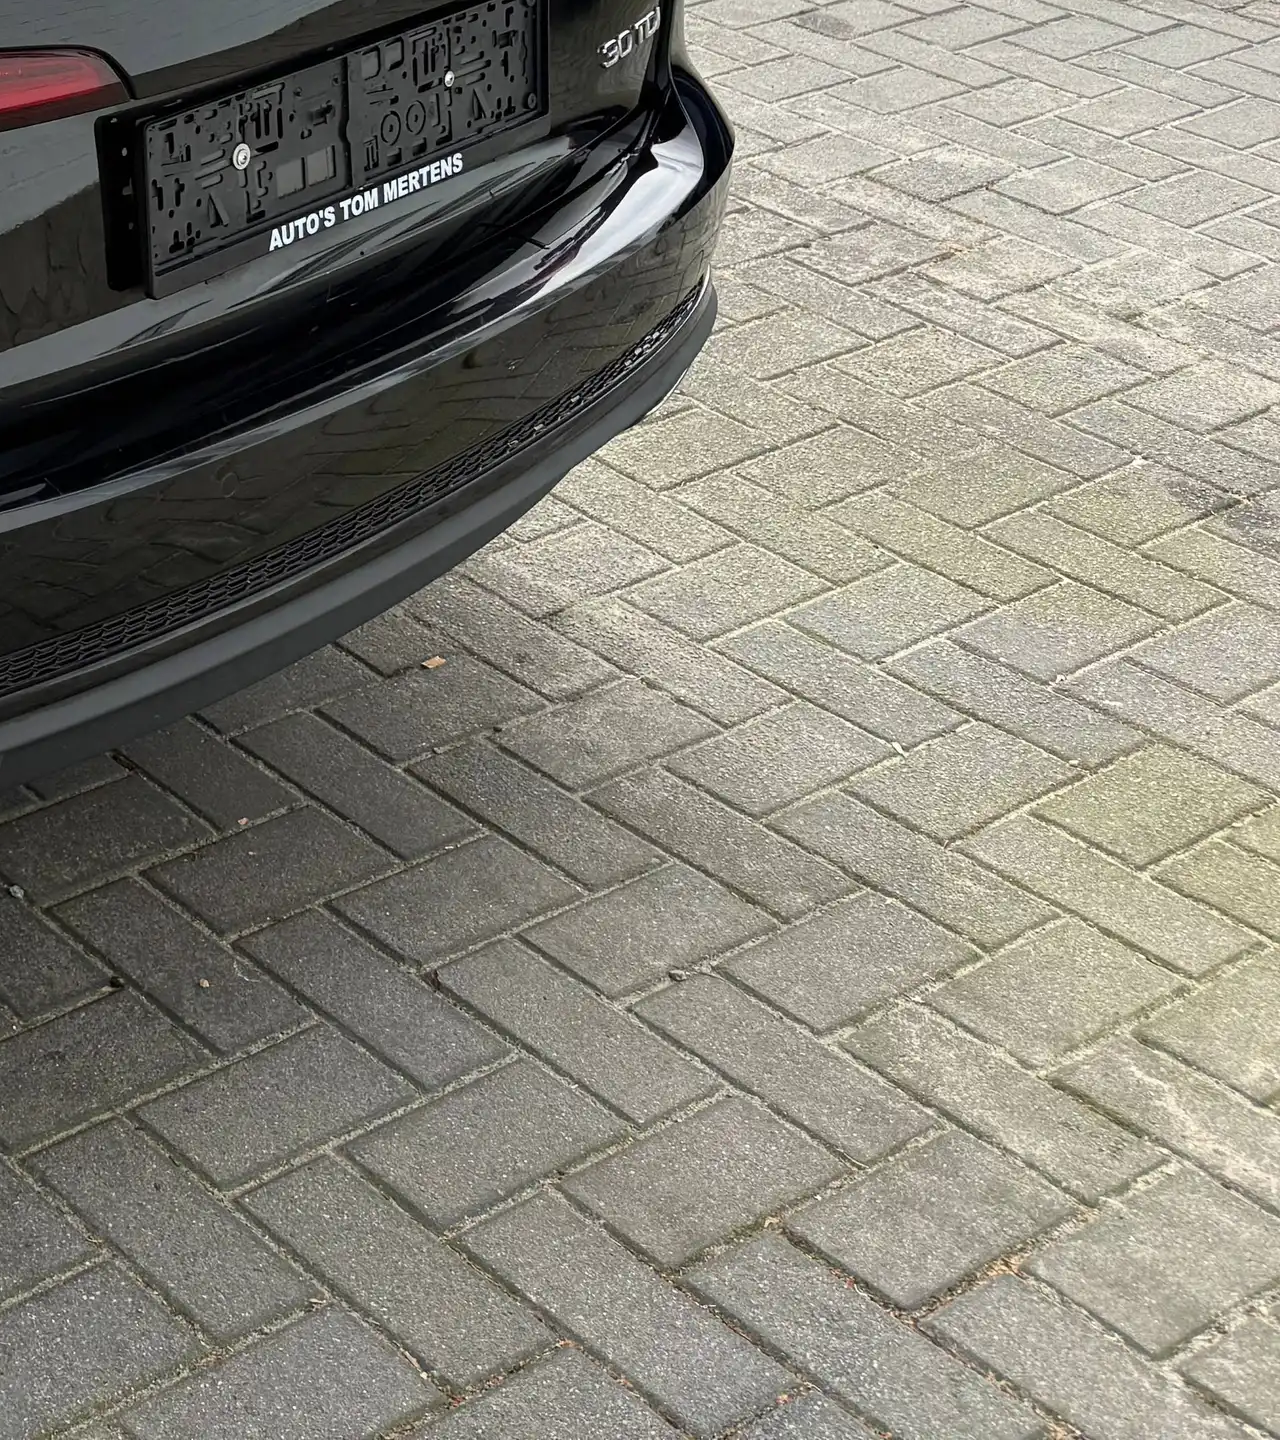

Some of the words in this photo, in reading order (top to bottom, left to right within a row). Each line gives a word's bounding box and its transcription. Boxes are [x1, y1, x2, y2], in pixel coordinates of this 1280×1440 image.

[268, 205, 336, 252] AUTO'S
[339, 186, 379, 220] TOM
[383, 152, 464, 204] MERTENS
